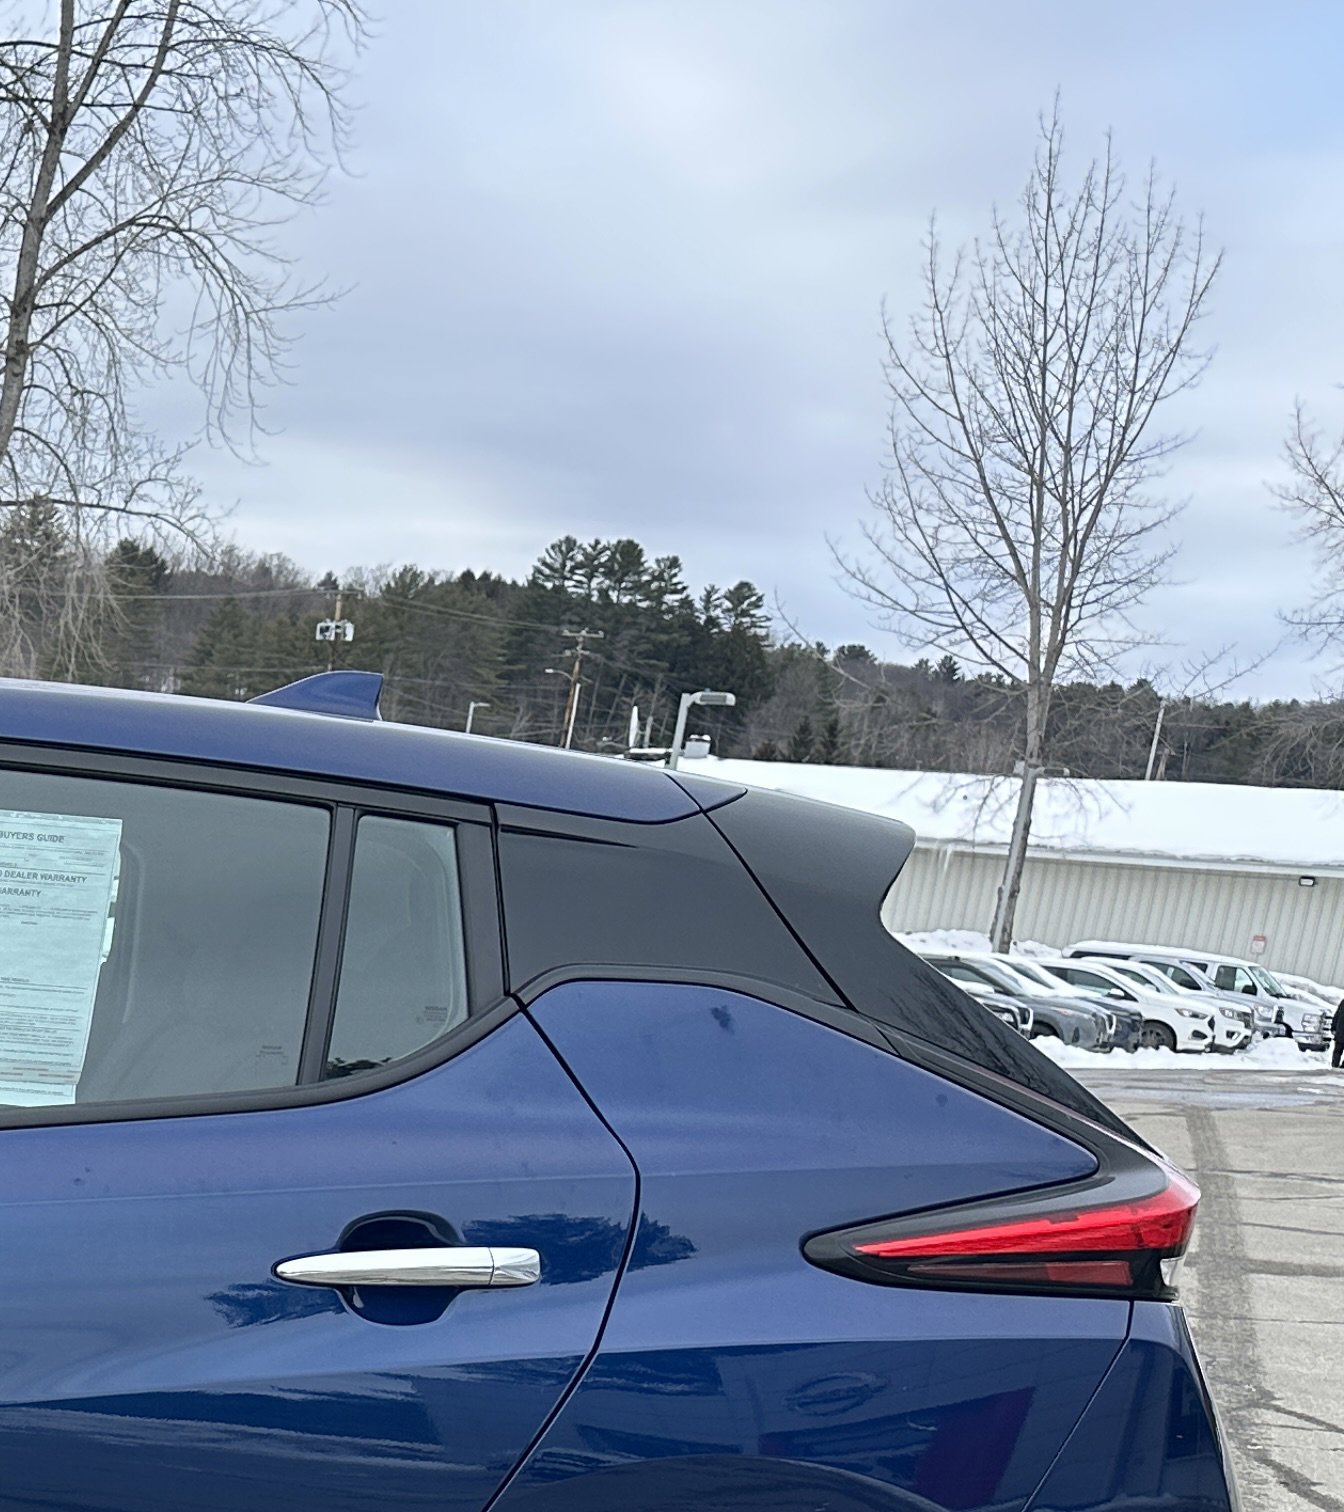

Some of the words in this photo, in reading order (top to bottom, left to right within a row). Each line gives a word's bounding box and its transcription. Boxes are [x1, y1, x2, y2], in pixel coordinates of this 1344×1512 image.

[36, 833, 65, 843] GUIDE
[4, 871, 38, 880] DEALER
[39, 873, 88, 884] WARRANTY
